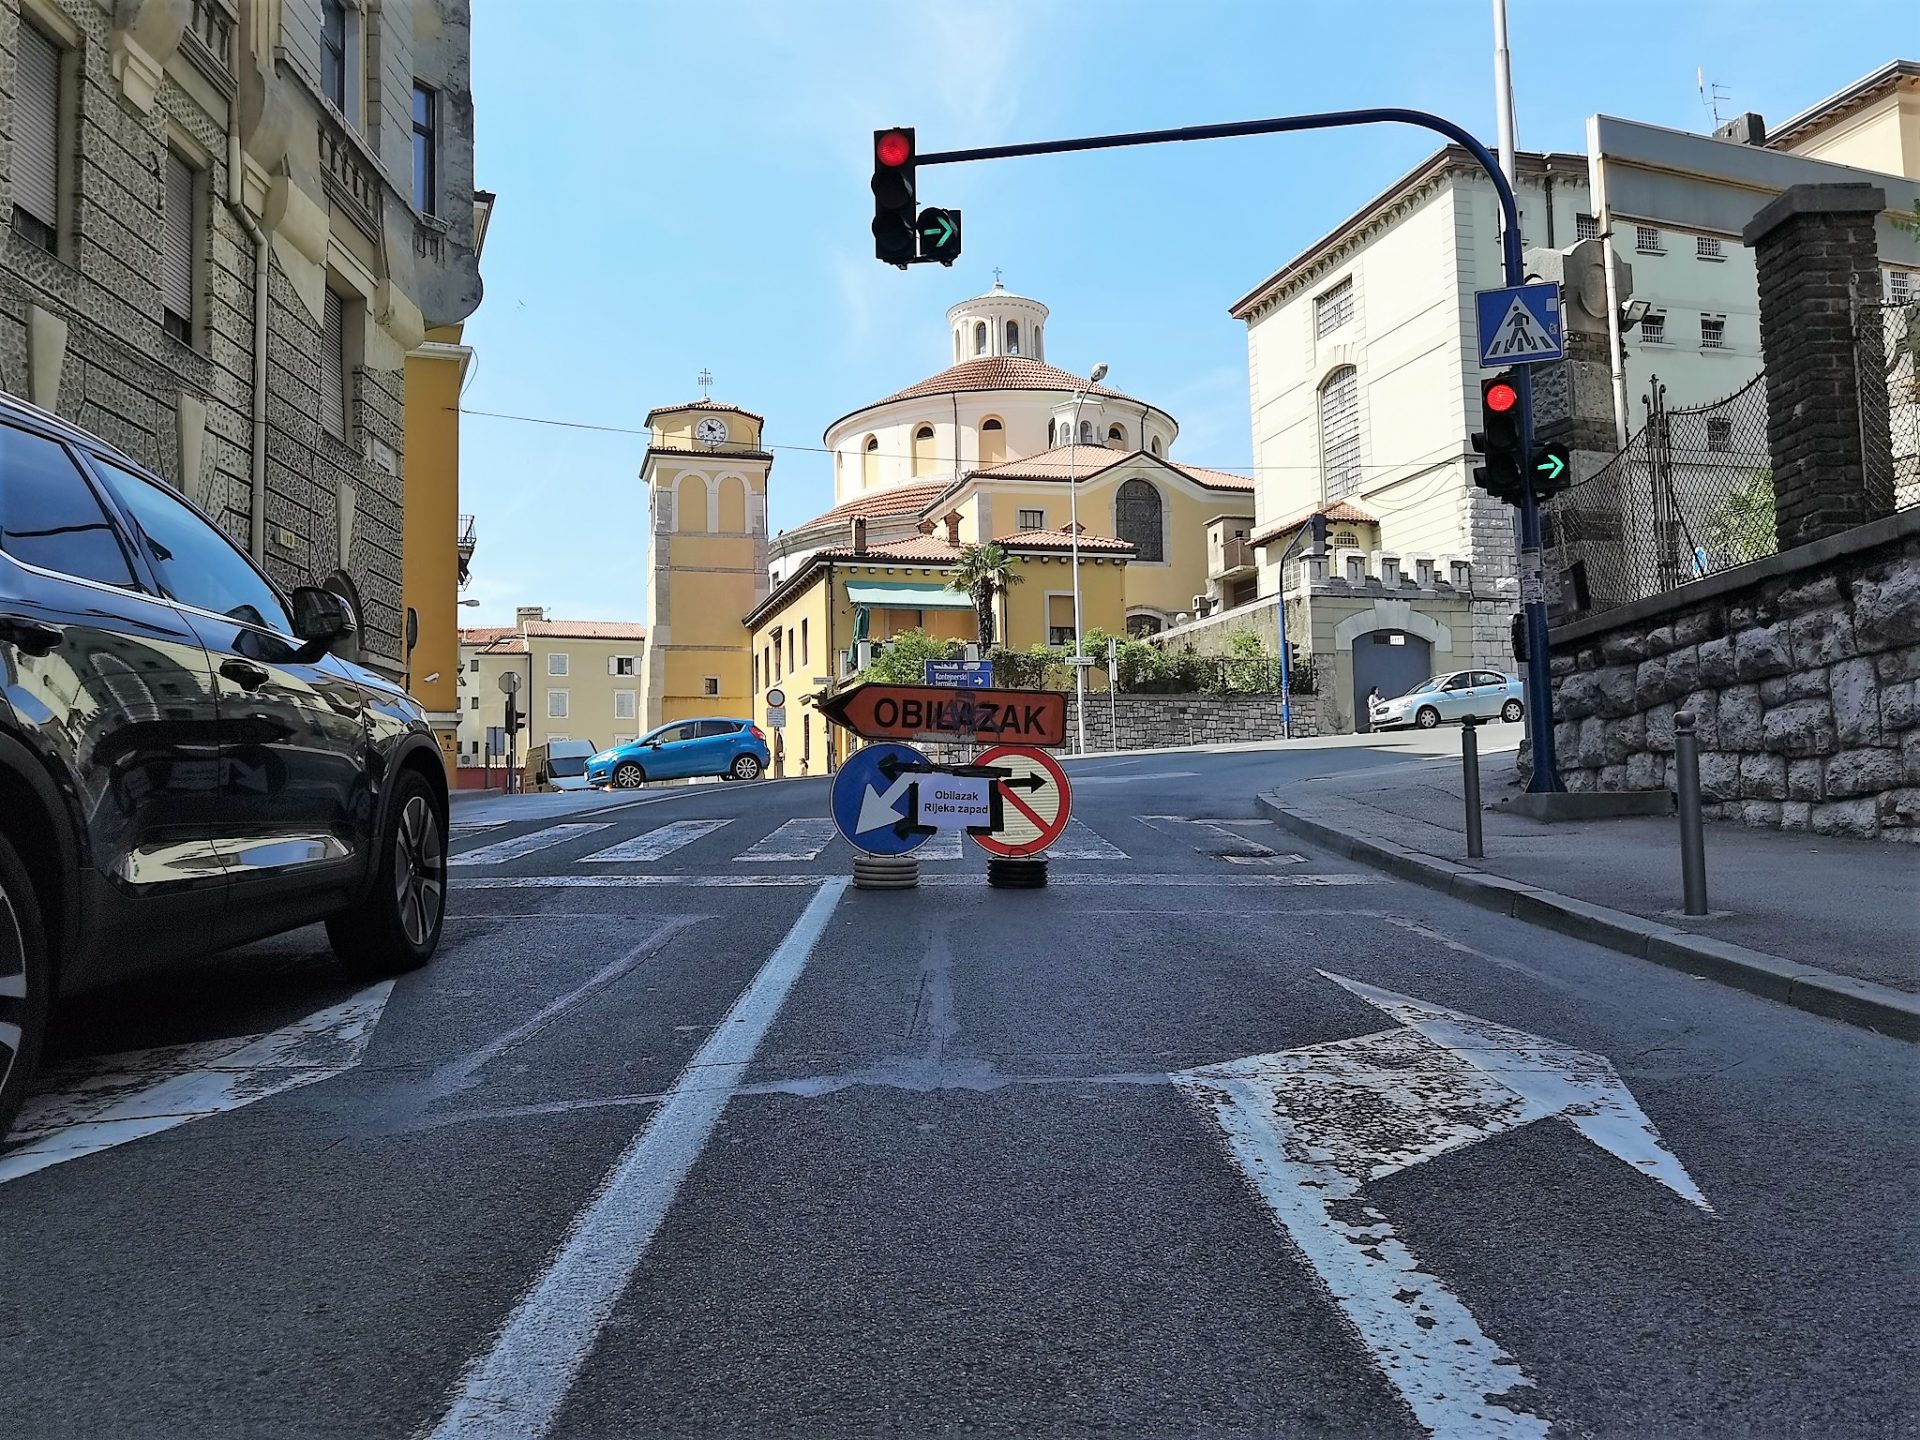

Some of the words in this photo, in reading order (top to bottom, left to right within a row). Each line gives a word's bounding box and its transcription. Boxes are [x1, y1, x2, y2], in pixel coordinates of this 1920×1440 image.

[874, 698, 1046, 735] OBILAZAK
[935, 790, 979, 801] Obilazak
[924, 802, 955, 814] Rijeka
[957, 805, 988, 815] zapad
